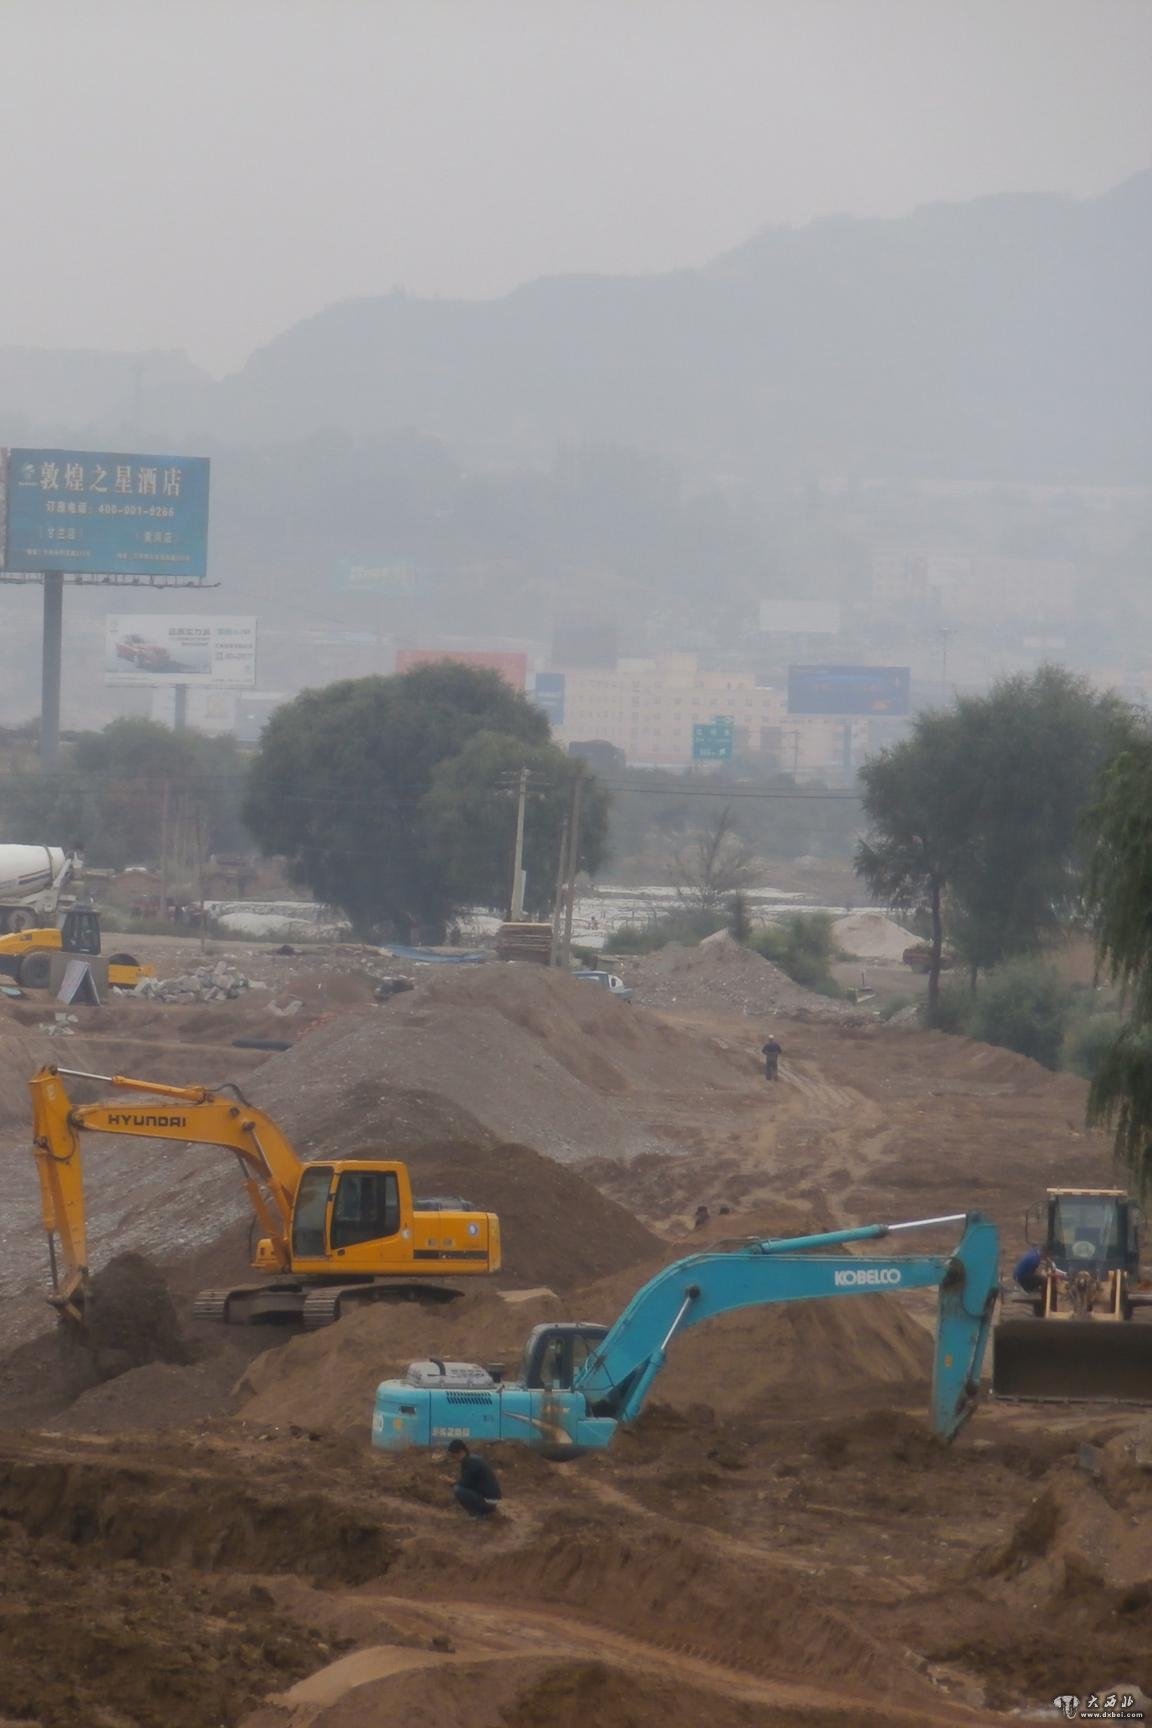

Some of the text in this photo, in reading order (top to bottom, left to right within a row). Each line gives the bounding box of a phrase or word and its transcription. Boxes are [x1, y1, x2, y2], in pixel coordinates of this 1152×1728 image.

[39, 461, 183, 497] 敦煌之星酒店
[107, 1114, 187, 1128] HYUNDAI
[834, 1268, 901, 1286] KOBELCO
